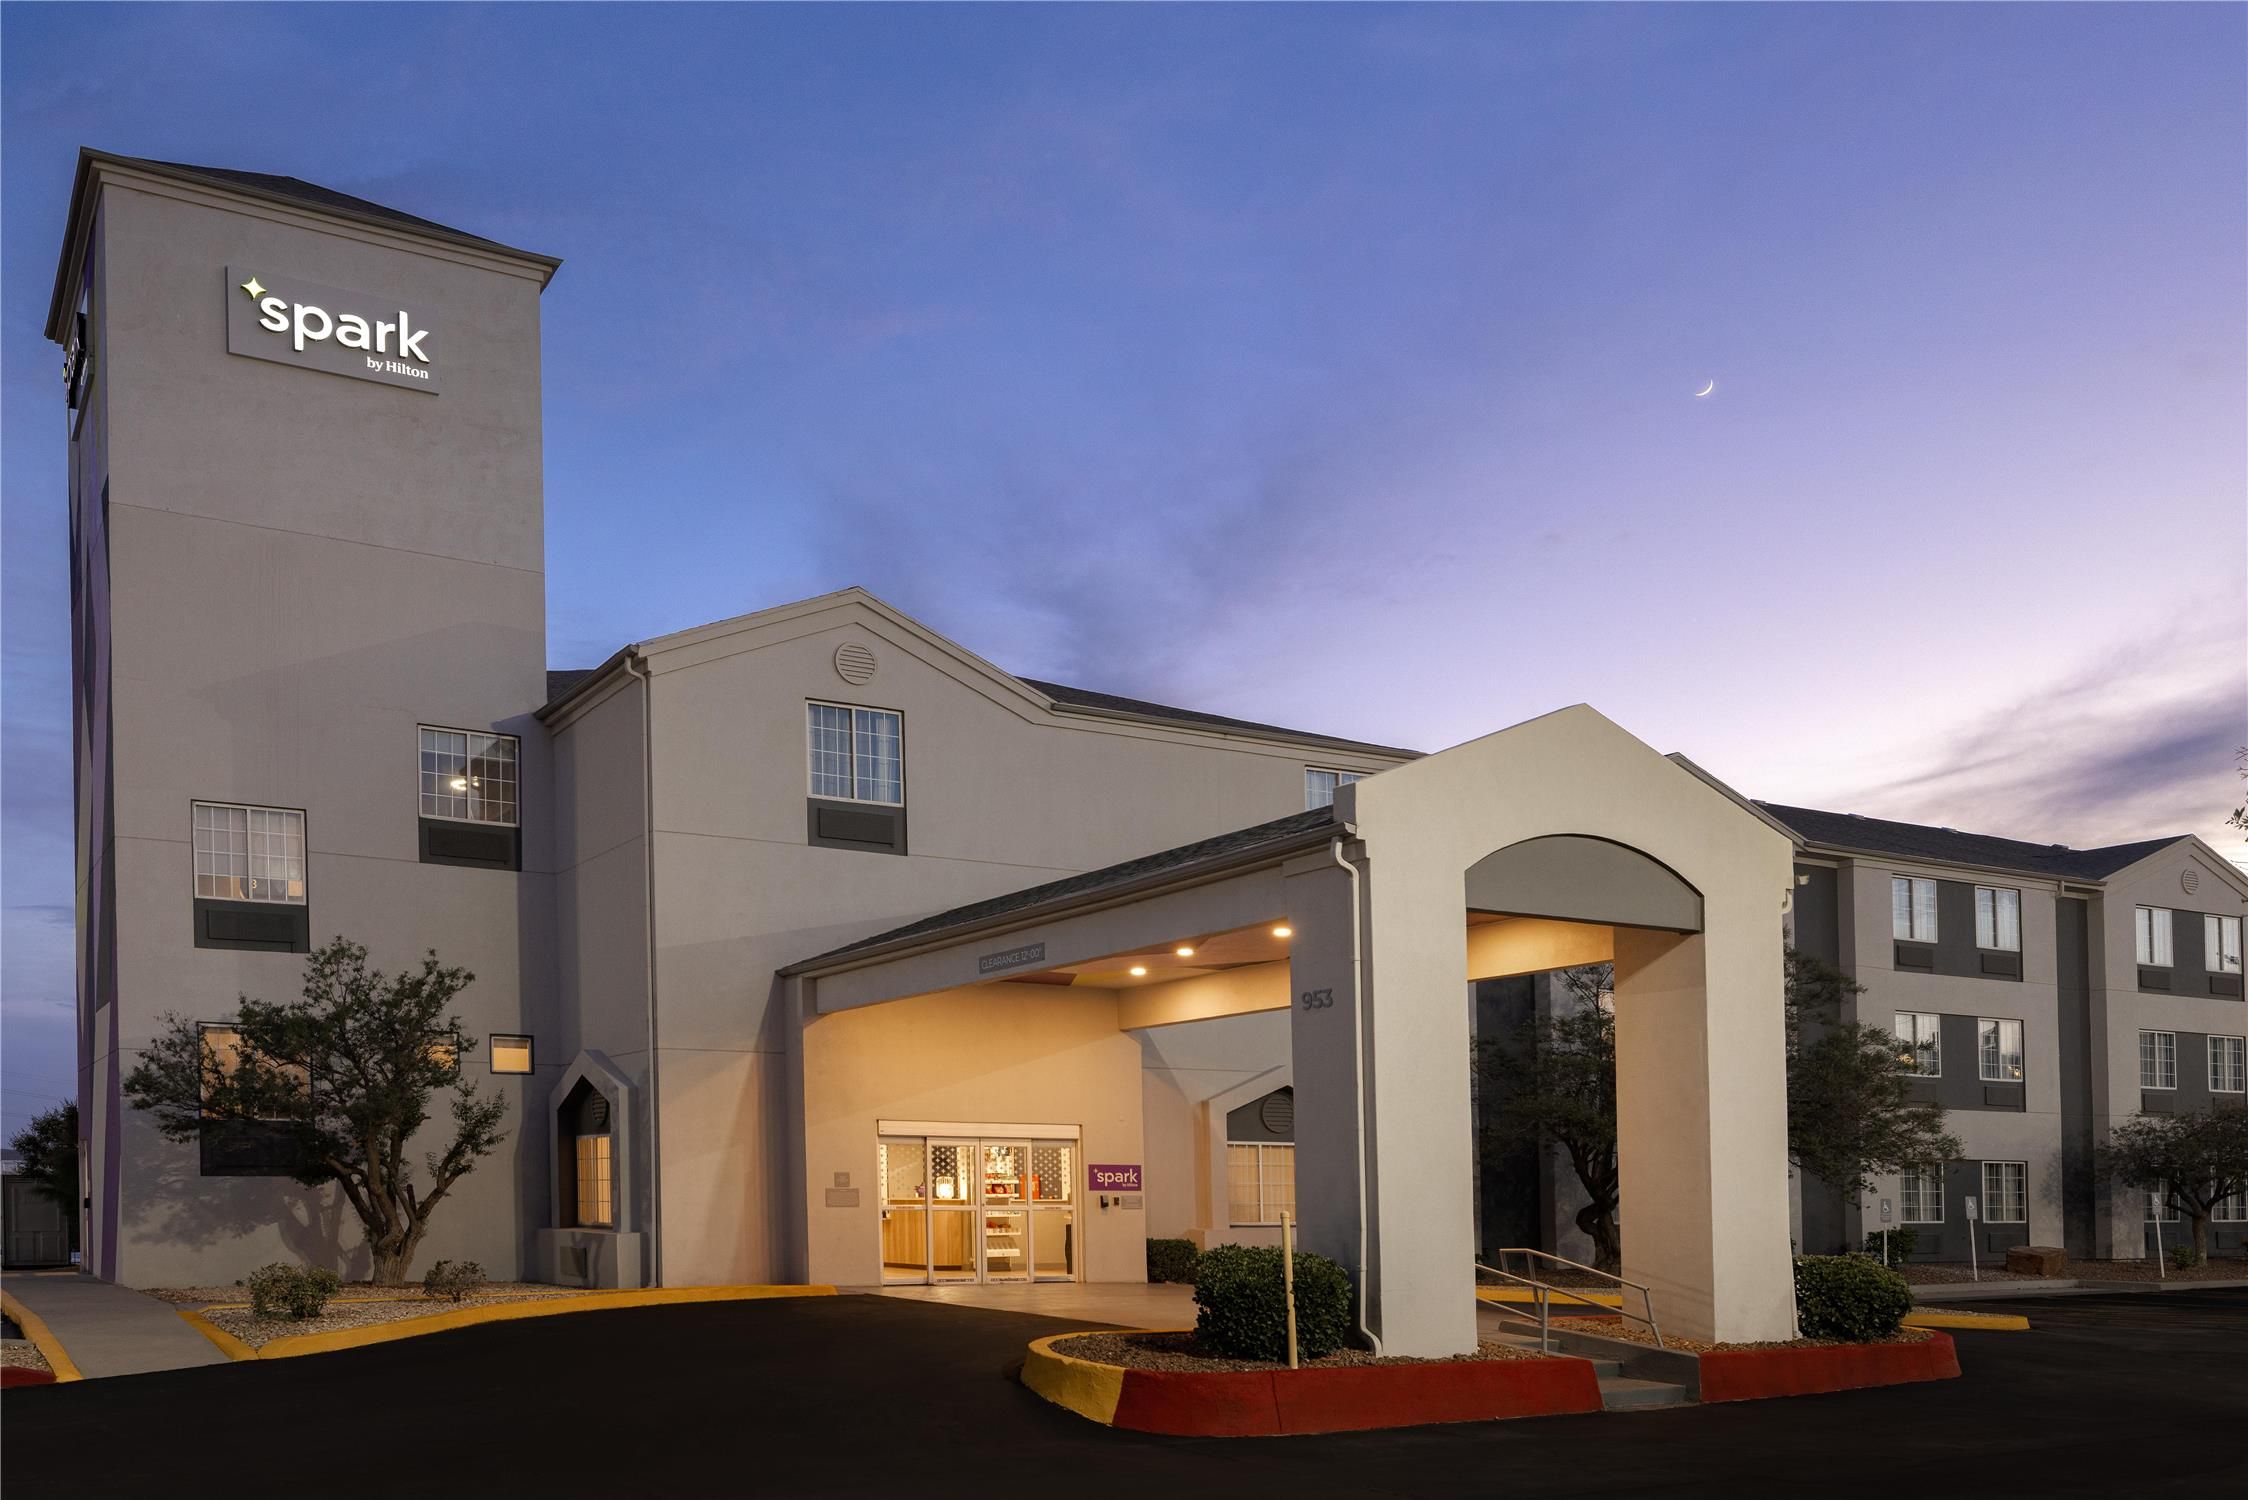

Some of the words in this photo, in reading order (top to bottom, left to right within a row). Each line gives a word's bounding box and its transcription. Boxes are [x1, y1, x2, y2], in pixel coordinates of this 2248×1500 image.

[259, 297, 429, 363] spark
[367, 355, 383, 372] by
[386, 360, 429, 379] Hilton
[981, 952, 1020, 970] CLEARANCE
[1302, 988, 1333, 1011] 953
[1096, 1168, 1138, 1187] spark
